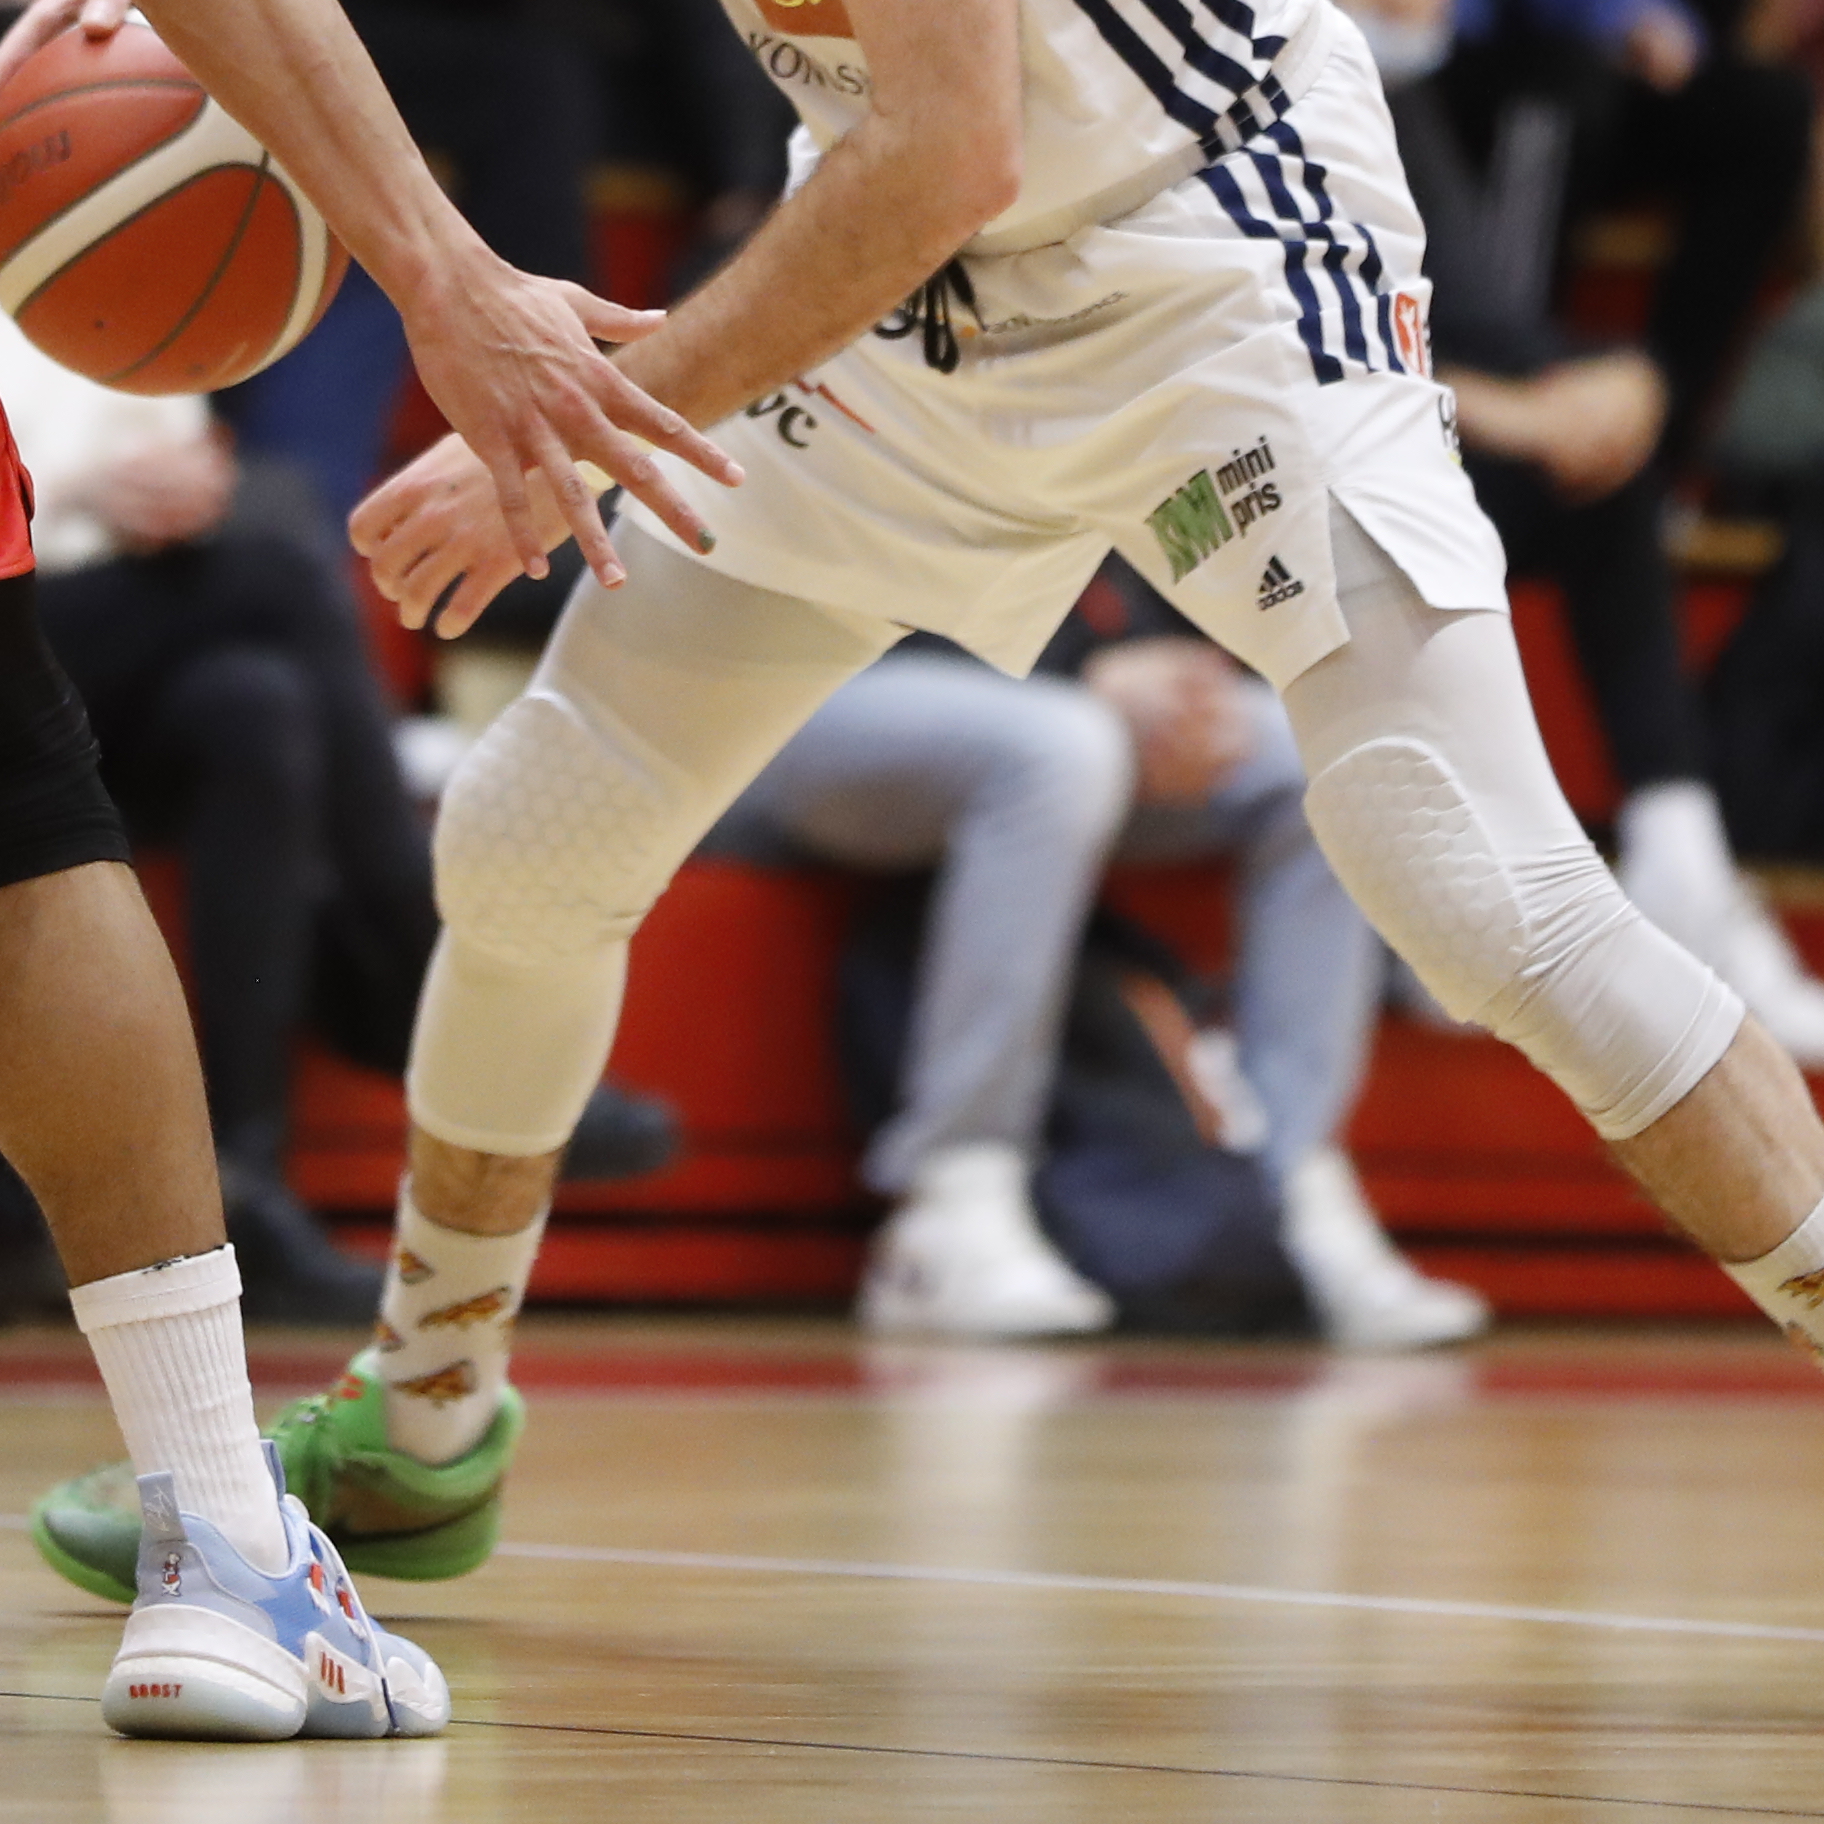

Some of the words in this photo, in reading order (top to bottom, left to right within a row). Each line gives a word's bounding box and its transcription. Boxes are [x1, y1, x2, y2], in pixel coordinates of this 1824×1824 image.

[1216, 435, 1276, 496] mini
[1230, 482, 1283, 539] pris
[129, 1682, 183, 1699] BOOST
